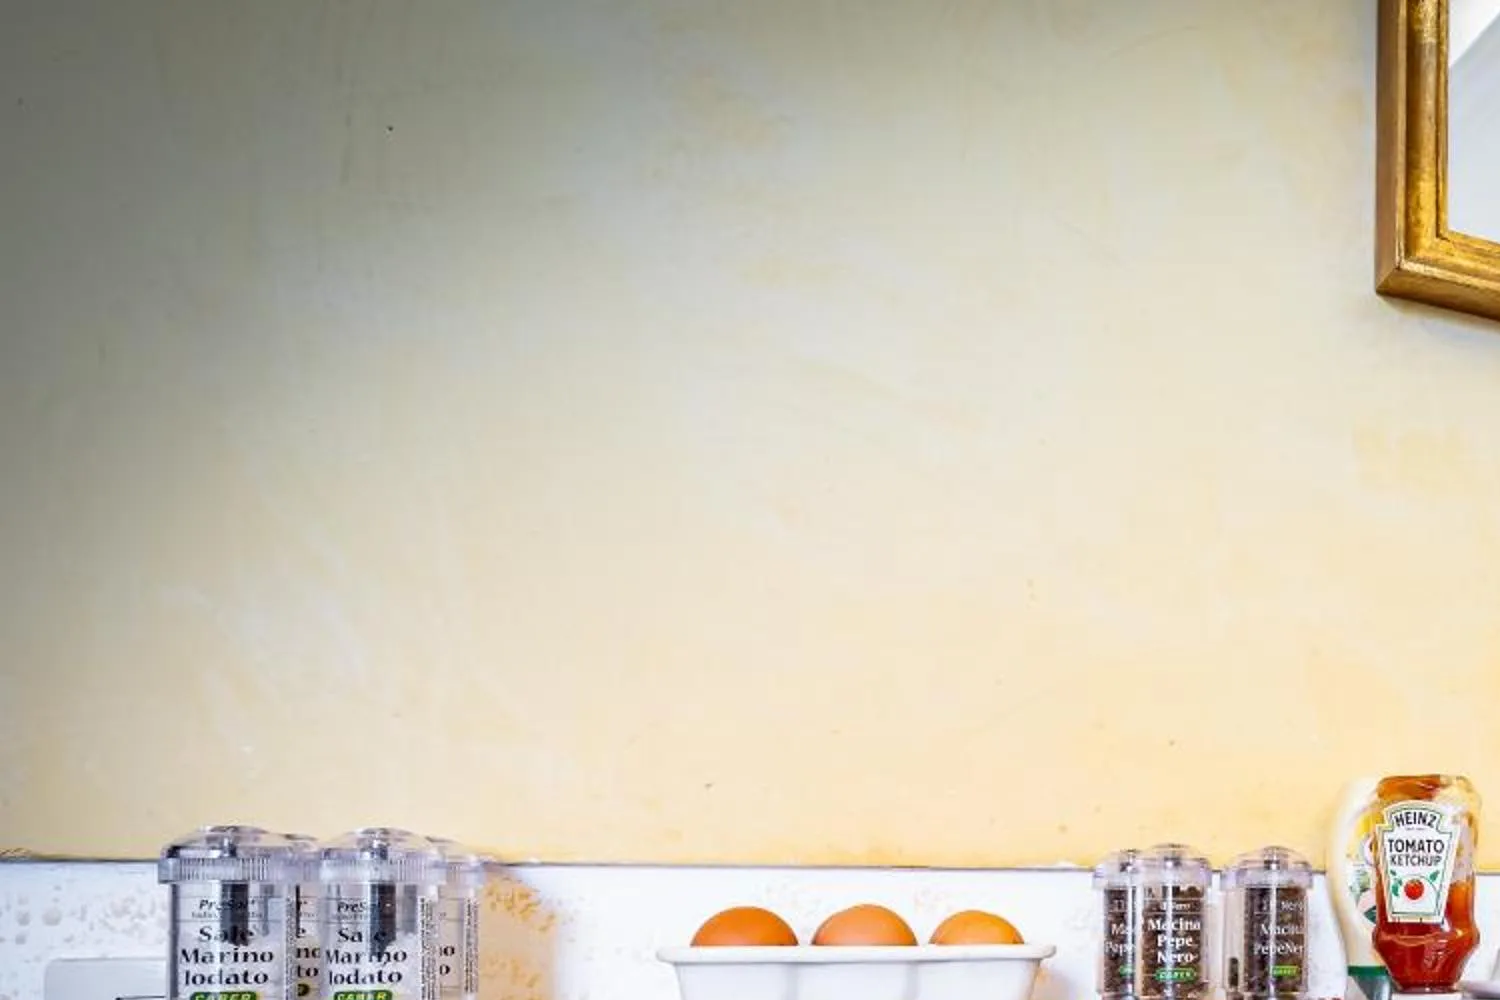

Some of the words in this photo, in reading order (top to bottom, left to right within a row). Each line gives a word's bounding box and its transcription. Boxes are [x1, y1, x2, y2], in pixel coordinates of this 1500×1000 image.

[1394, 811, 1437, 828] HEINZ
[1388, 839, 1445, 853] TOMATO
[1390, 854, 1443, 867] KETCHUP
[198, 925, 254, 943] Sale
[337, 928, 387, 943] Sae
[1157, 934, 1194, 949] Pepe
[181, 947, 274, 964] Marino
[1157, 951, 1195, 963] Nero
